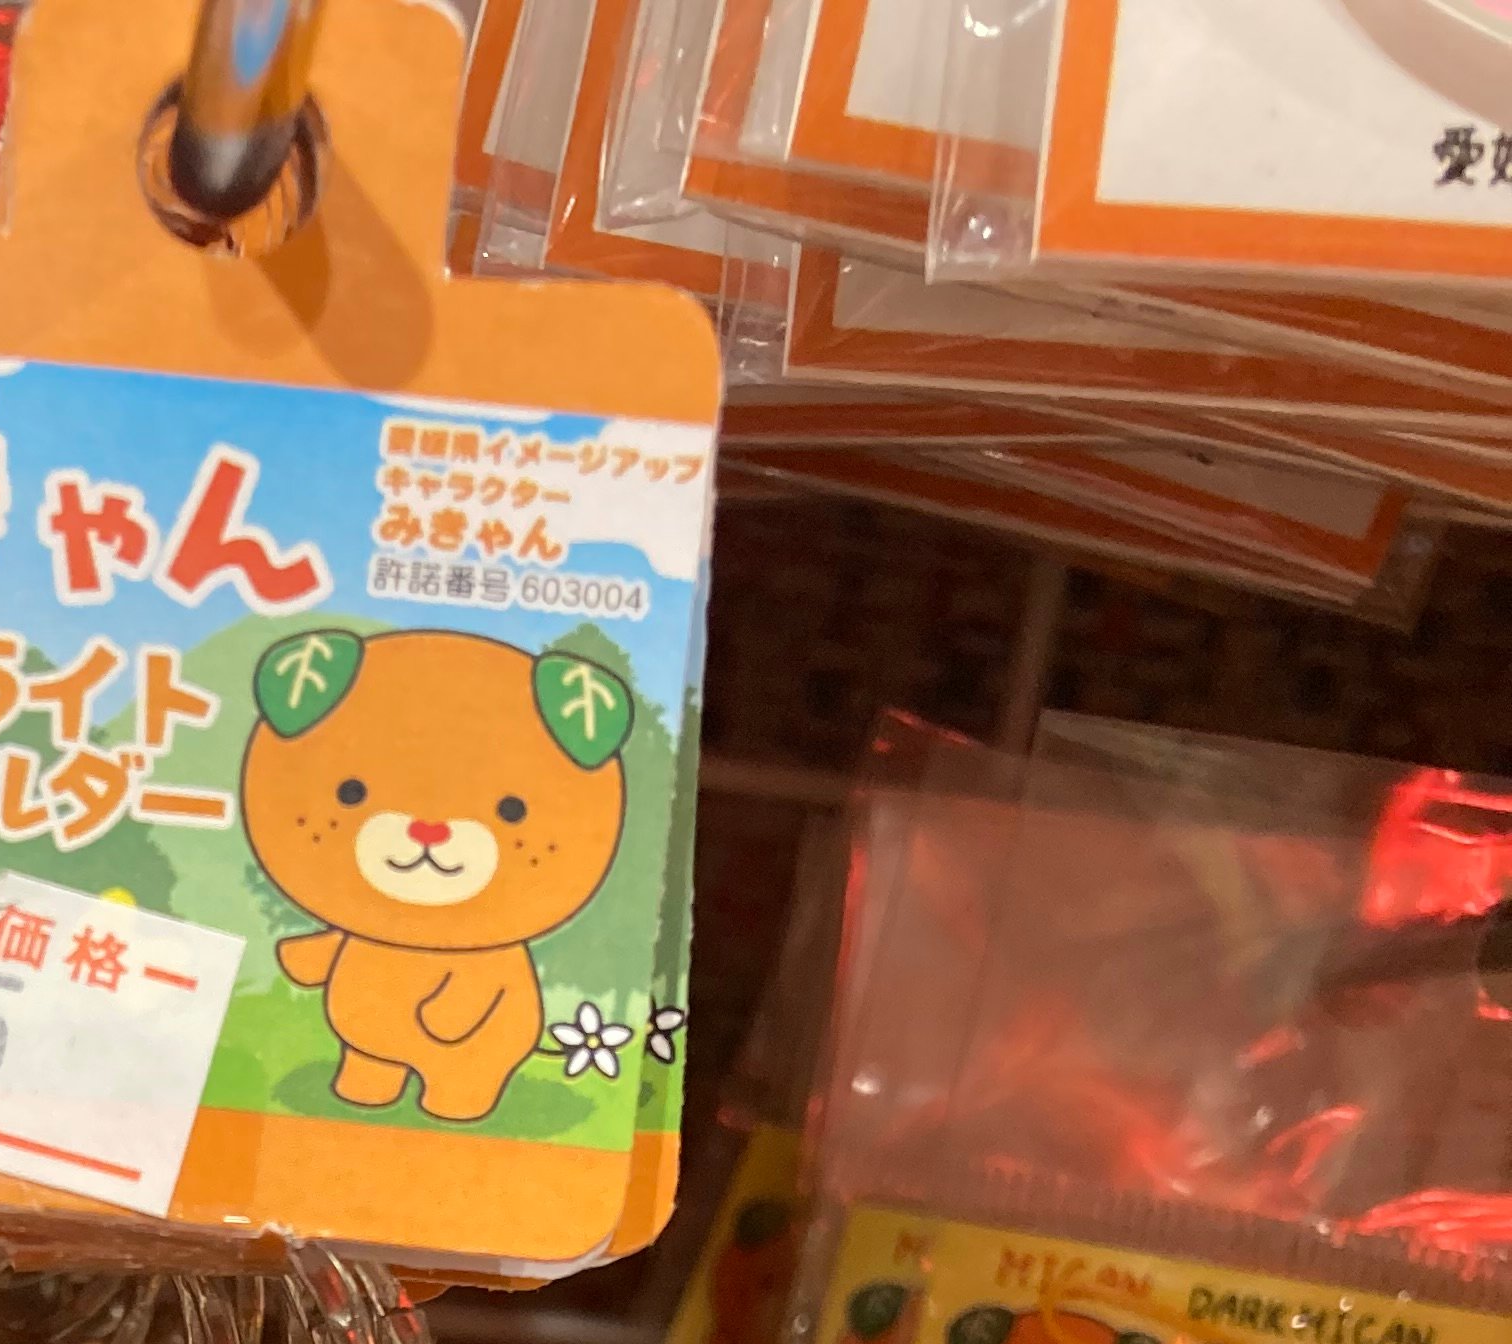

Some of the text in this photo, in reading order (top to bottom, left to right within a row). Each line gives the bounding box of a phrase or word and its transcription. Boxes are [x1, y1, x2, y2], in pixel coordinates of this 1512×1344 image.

[383, 466, 572, 509] キャラクター
[379, 504, 563, 562] みきゃん
